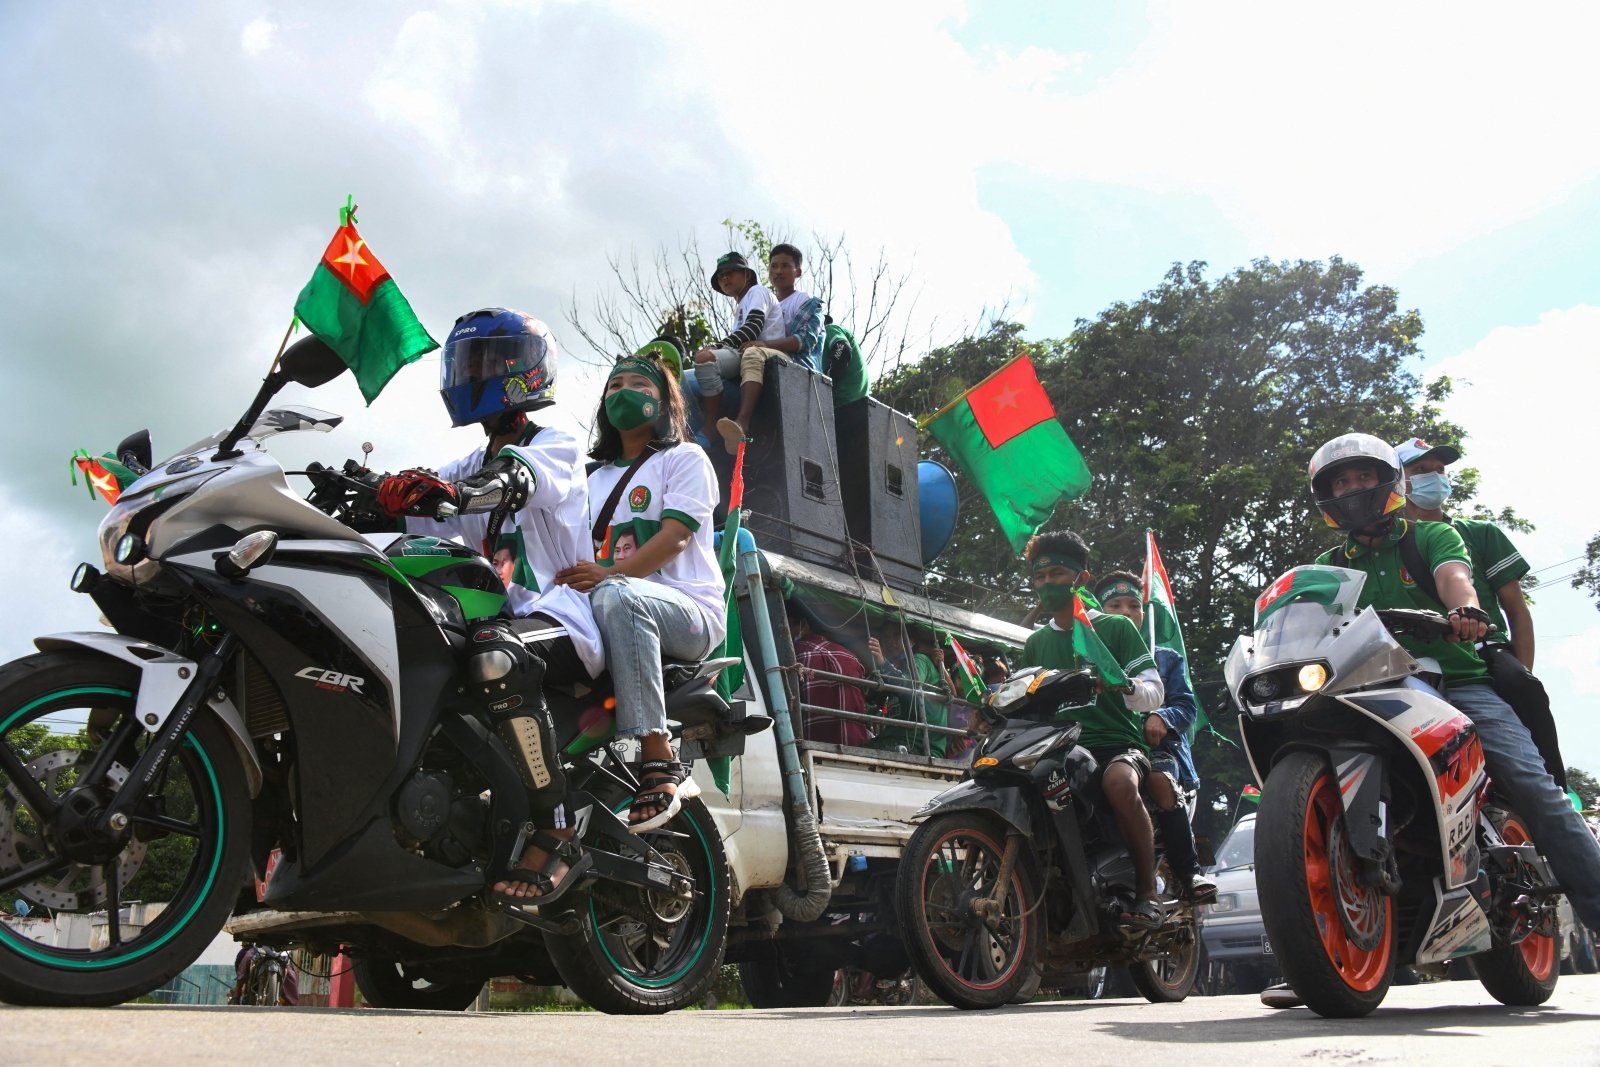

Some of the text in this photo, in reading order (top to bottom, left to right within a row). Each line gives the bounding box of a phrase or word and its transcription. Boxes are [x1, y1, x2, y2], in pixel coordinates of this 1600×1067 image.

[294, 666, 365, 694] CBR
[493, 702, 508, 711] PRO
[1436, 731, 1486, 805] KTM
